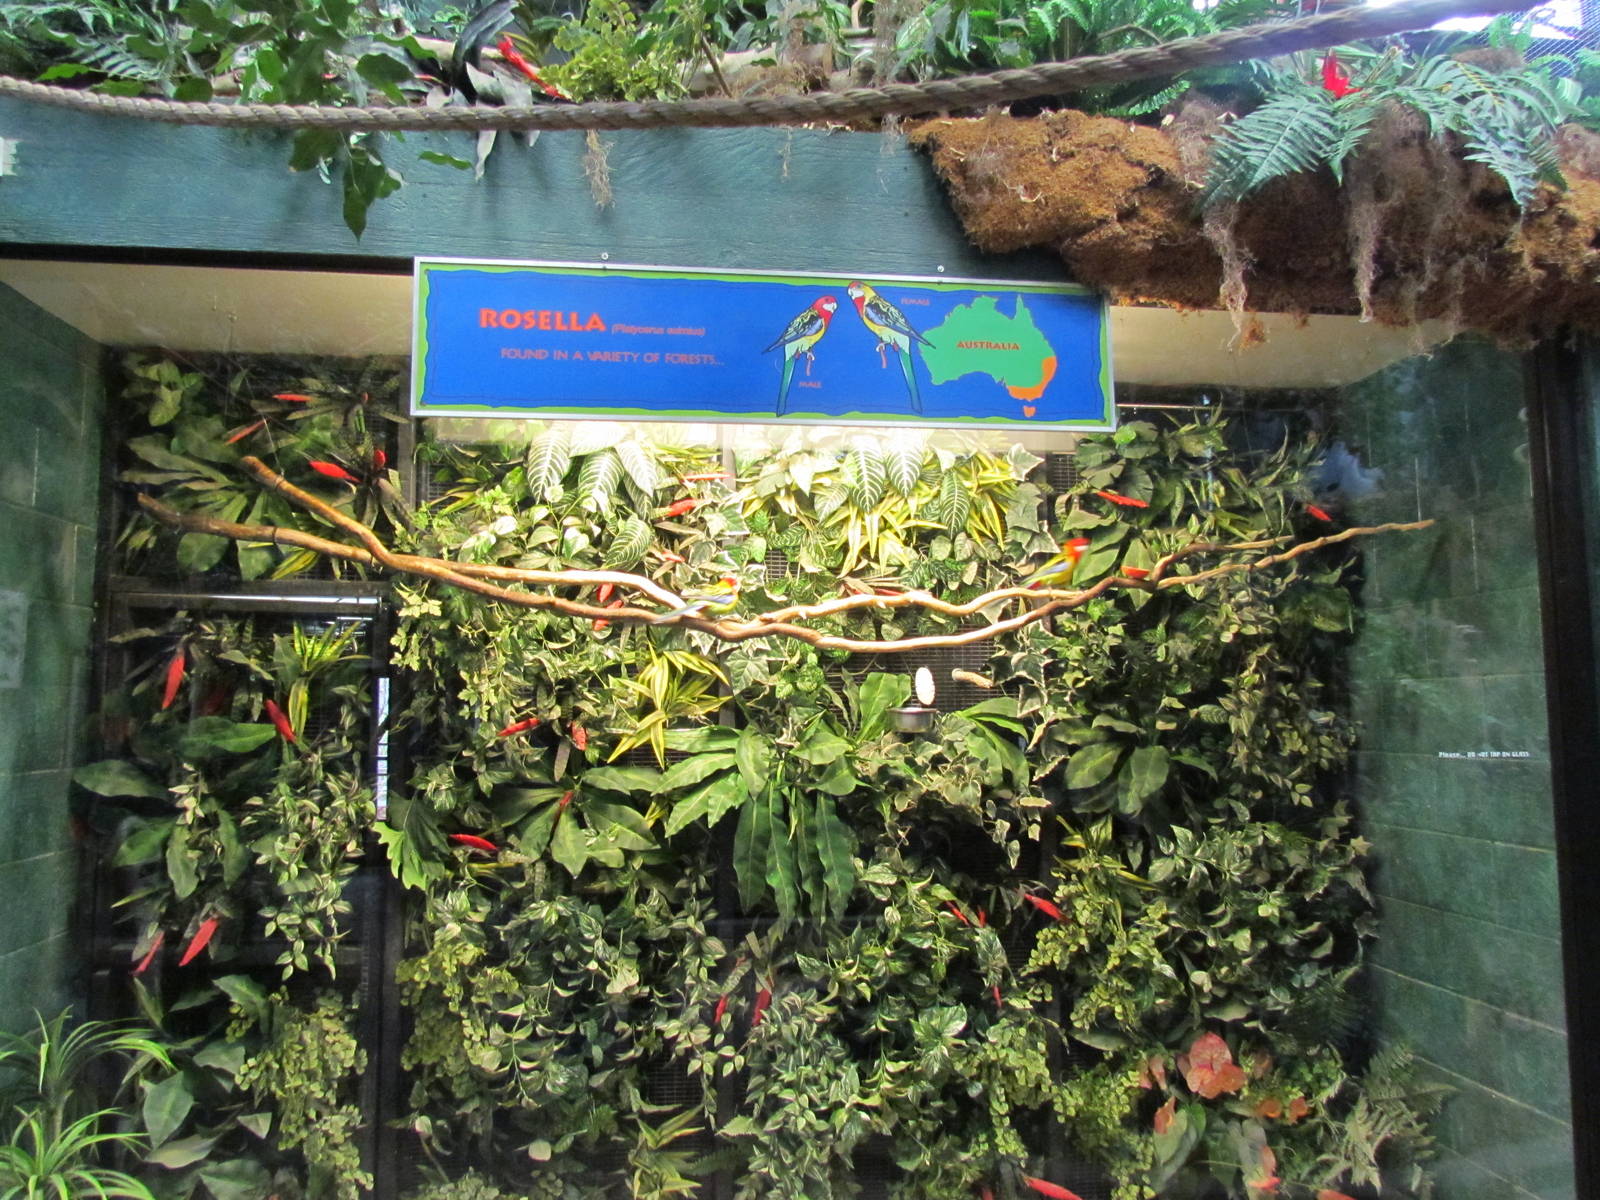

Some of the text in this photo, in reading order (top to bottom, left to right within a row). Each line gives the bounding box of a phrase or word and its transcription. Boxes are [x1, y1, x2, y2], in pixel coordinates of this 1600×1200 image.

[480, 308, 606, 332] ROSELLA
[956, 341, 1020, 351] AUSTRALIA
[501, 348, 724, 366] FOUND IN A VARIETY OF FORESTS...
